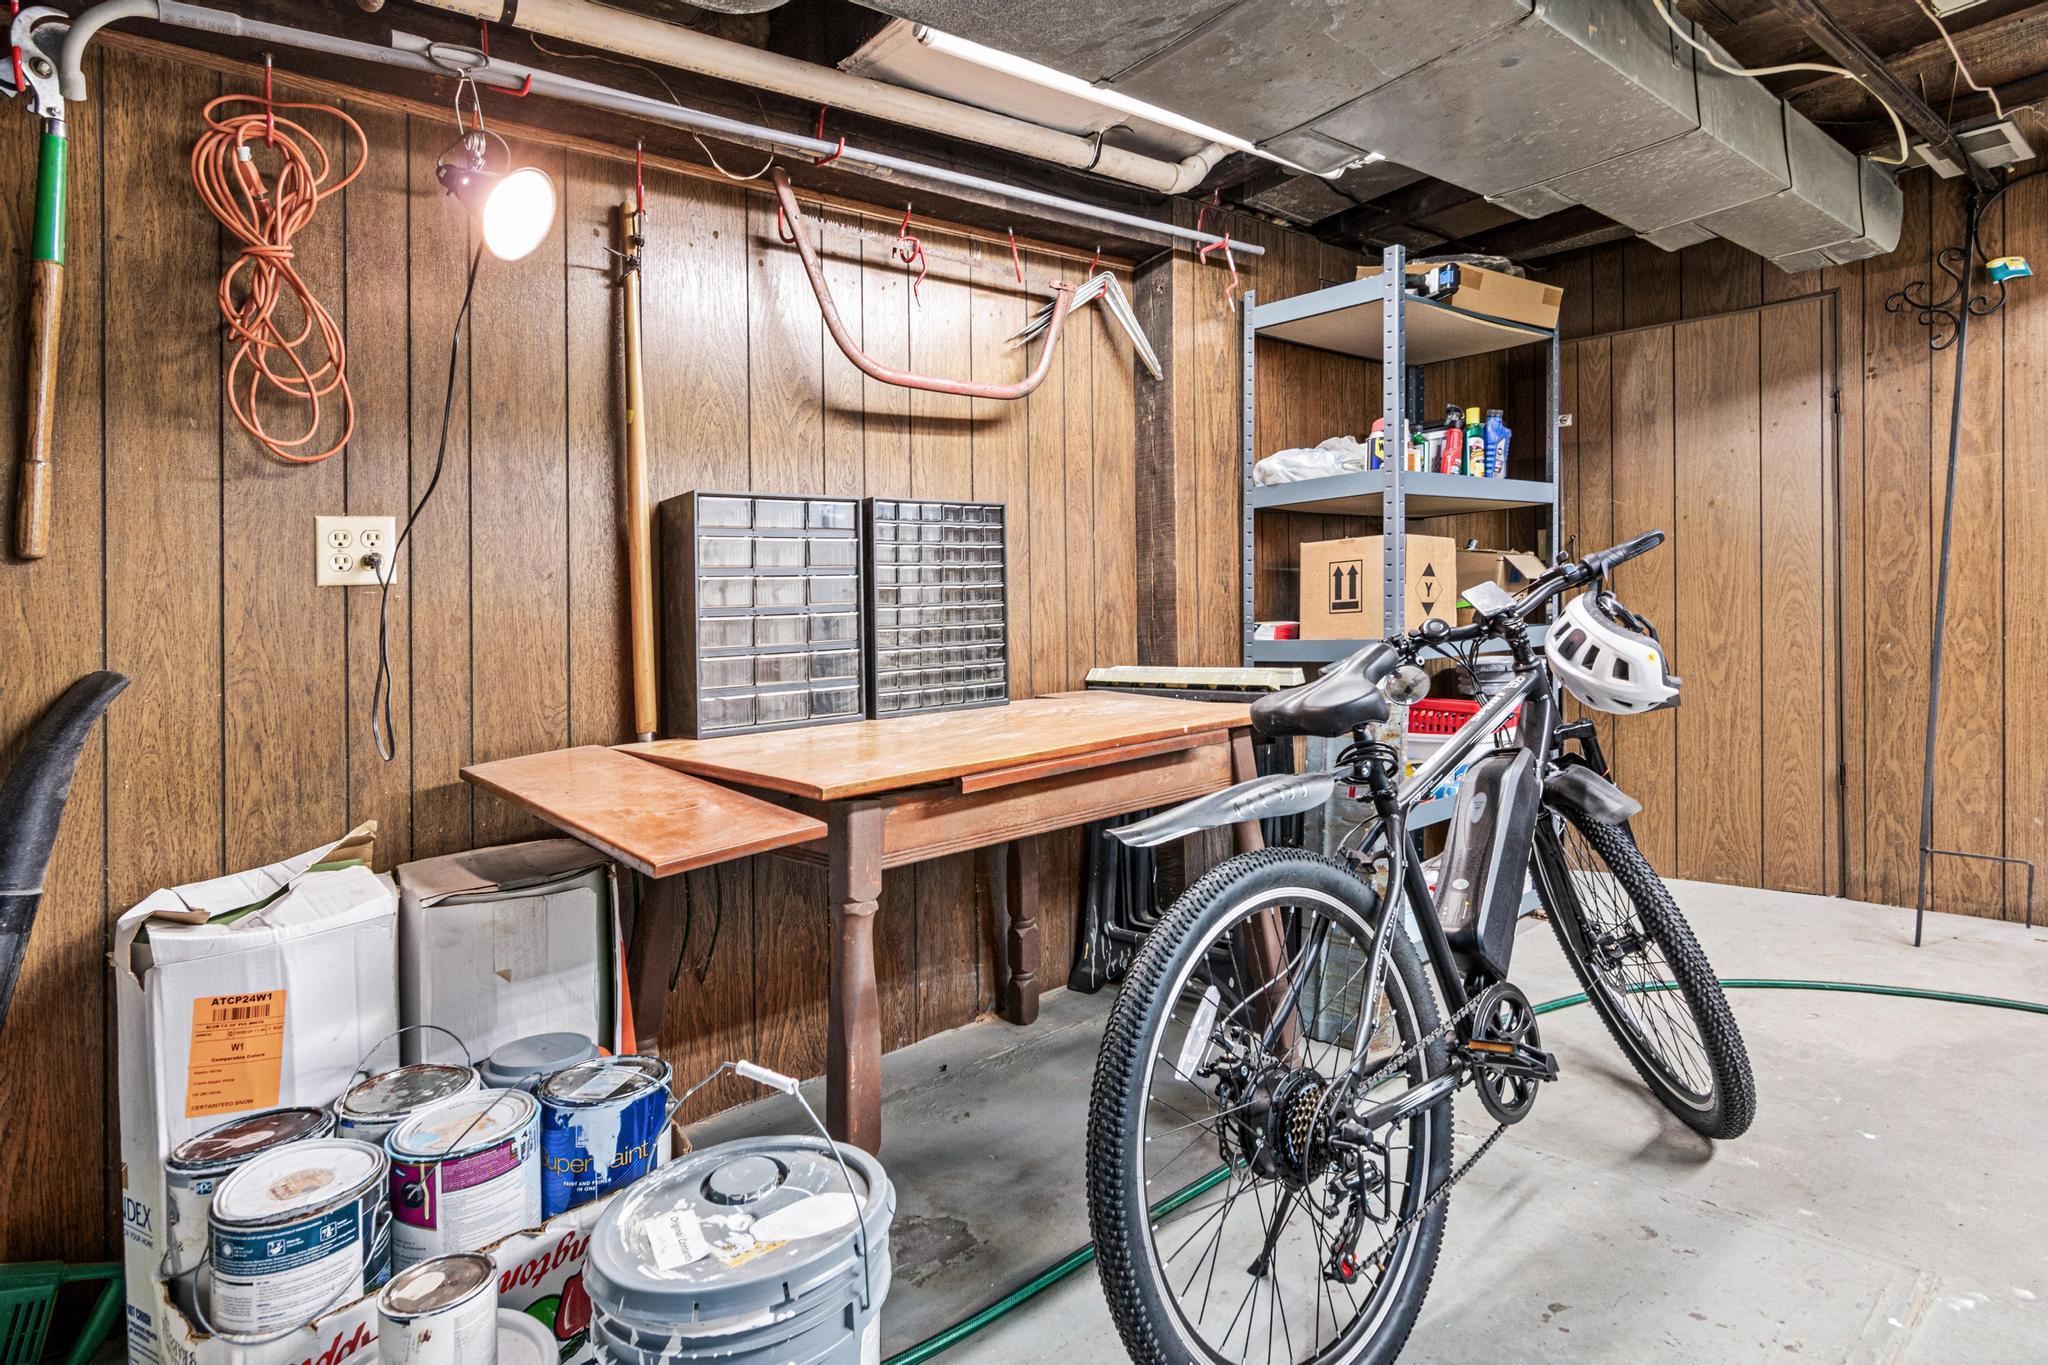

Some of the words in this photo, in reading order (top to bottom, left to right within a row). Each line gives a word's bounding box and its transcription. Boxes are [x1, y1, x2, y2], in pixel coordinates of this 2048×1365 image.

[1425, 582, 1433, 597] Y
[211, 993, 272, 1006] ATCP24W1
[231, 1043, 244, 1051] W1
[191, 1101, 234, 1110] CERTAINTEED
[497, 1231, 591, 1294] ngton
